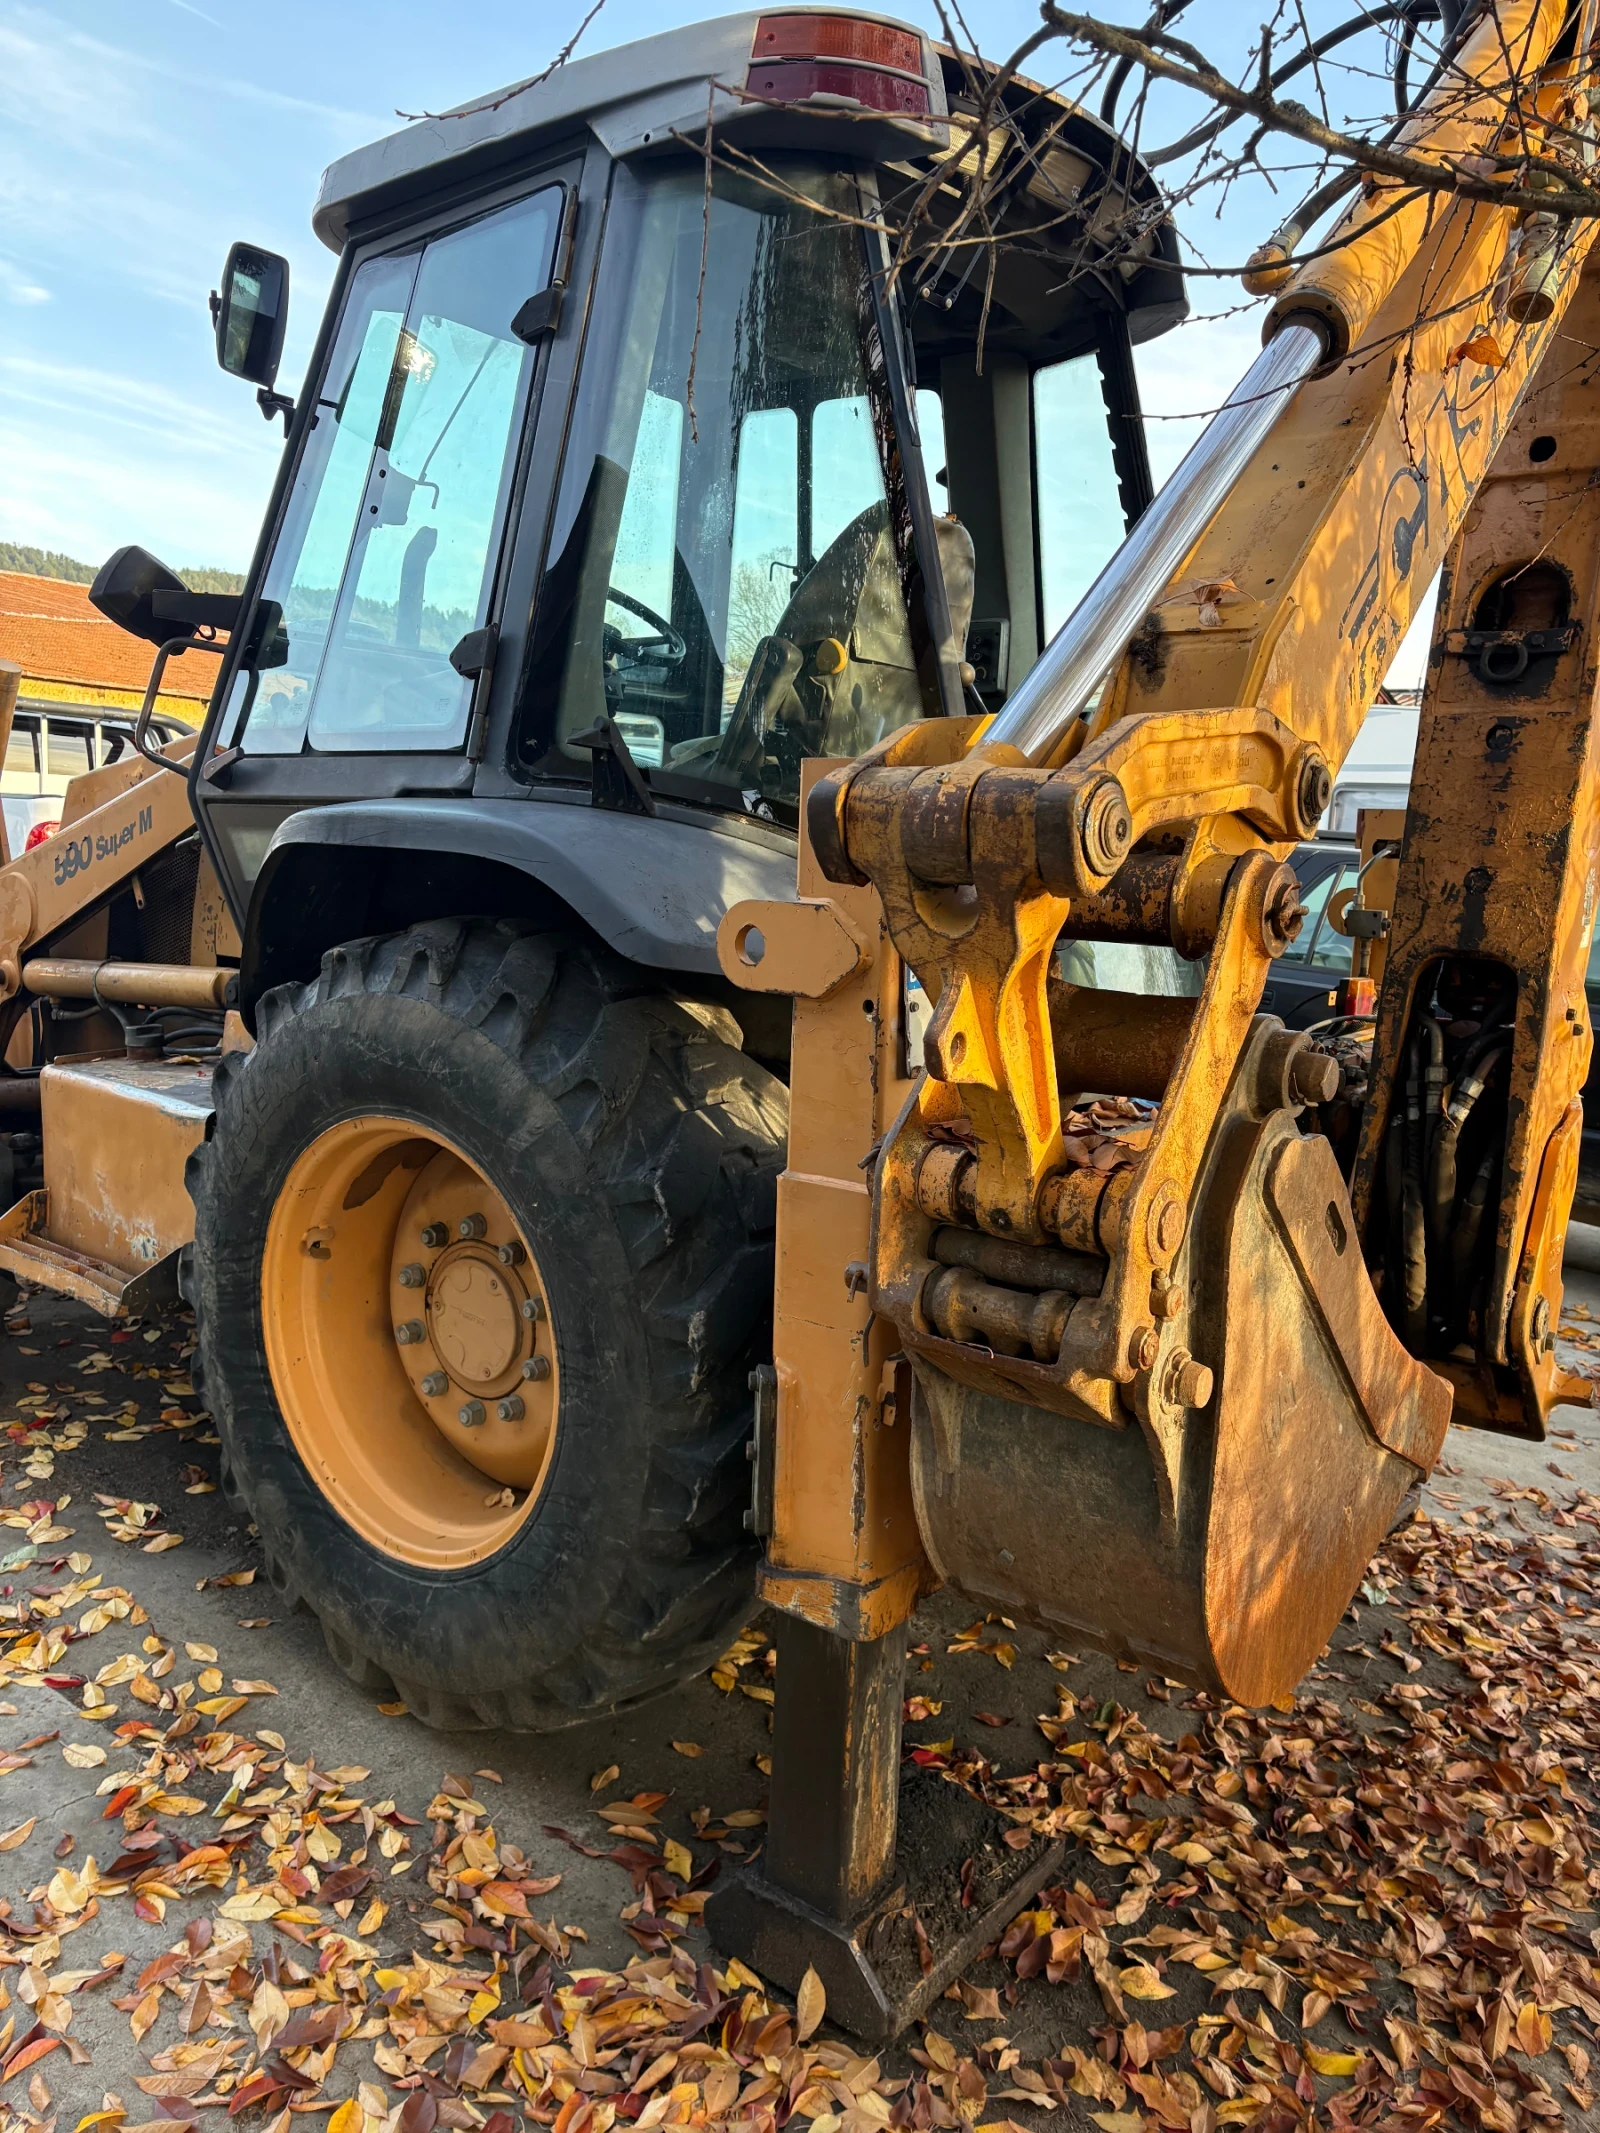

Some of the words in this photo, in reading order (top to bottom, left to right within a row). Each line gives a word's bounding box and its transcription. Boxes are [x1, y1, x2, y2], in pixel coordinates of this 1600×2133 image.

[54, 835, 92, 885] 590
[96, 821, 136, 860] Super
[139, 804, 152, 835] M
